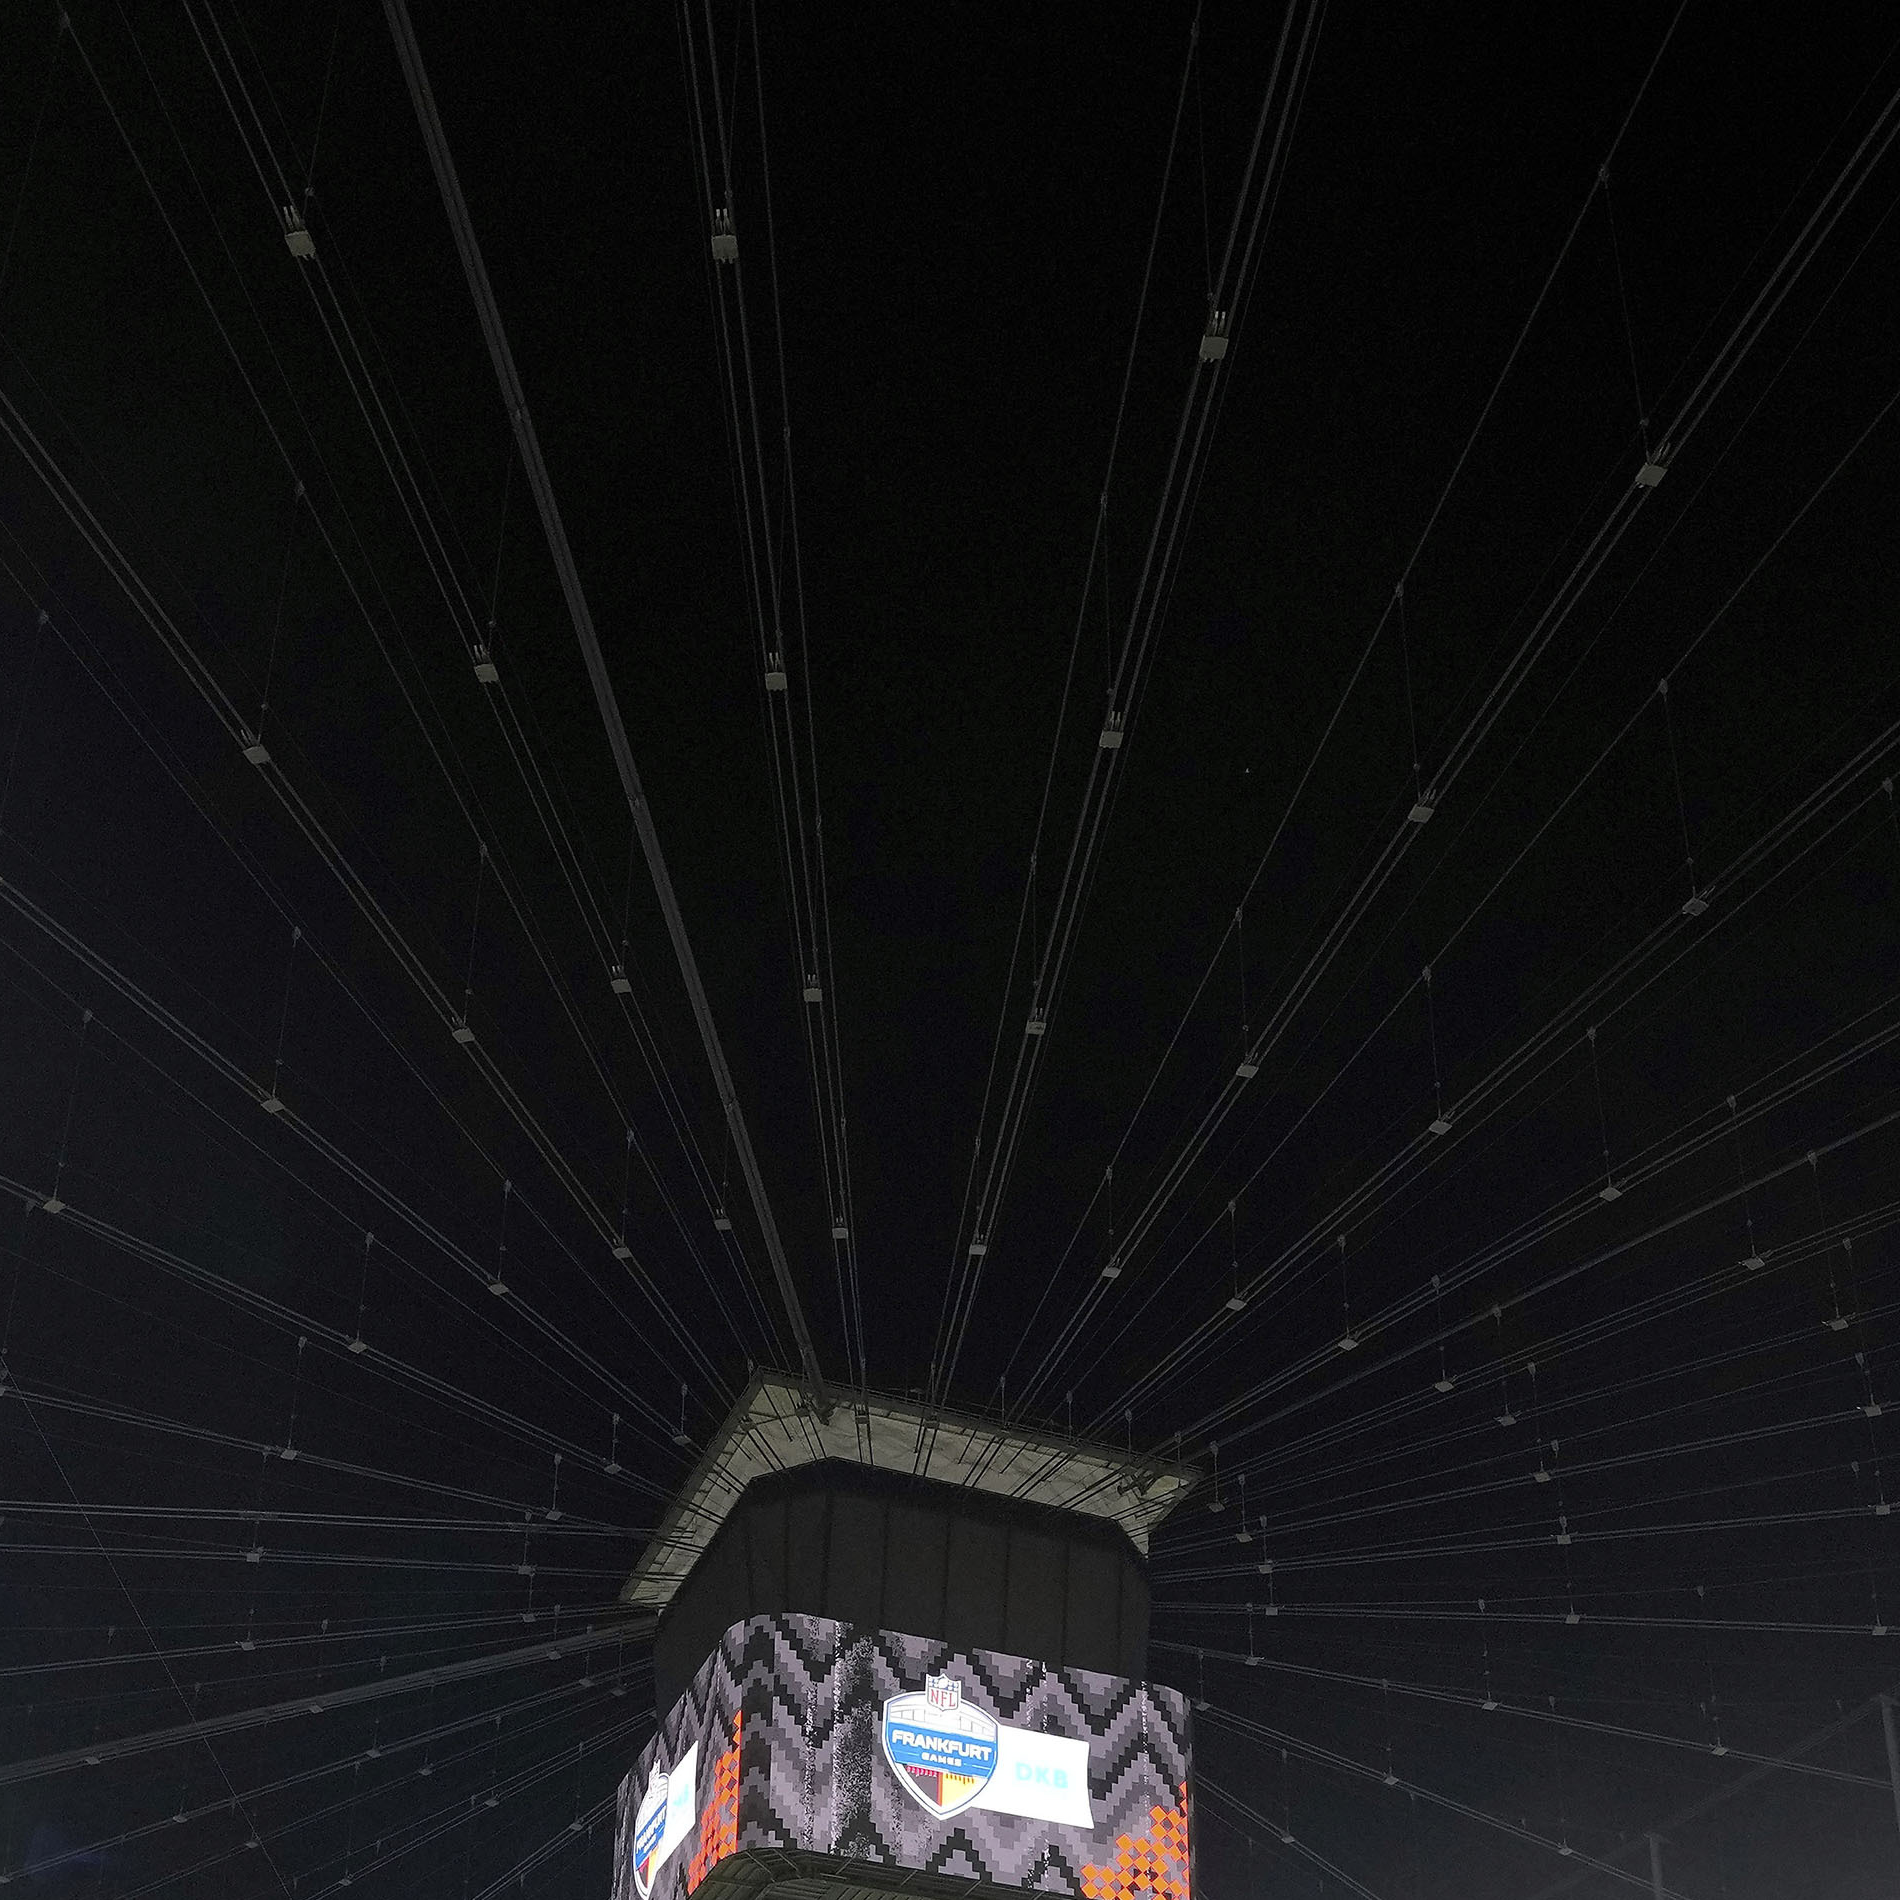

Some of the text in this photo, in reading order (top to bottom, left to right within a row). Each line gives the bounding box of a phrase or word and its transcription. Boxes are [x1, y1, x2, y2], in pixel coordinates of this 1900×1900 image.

[930, 1688, 956, 1707] NFL
[892, 1729, 992, 1761] FRANKFURT
[921, 1752, 962, 1767] GAMES
[1015, 1762, 1069, 1789] DKB
